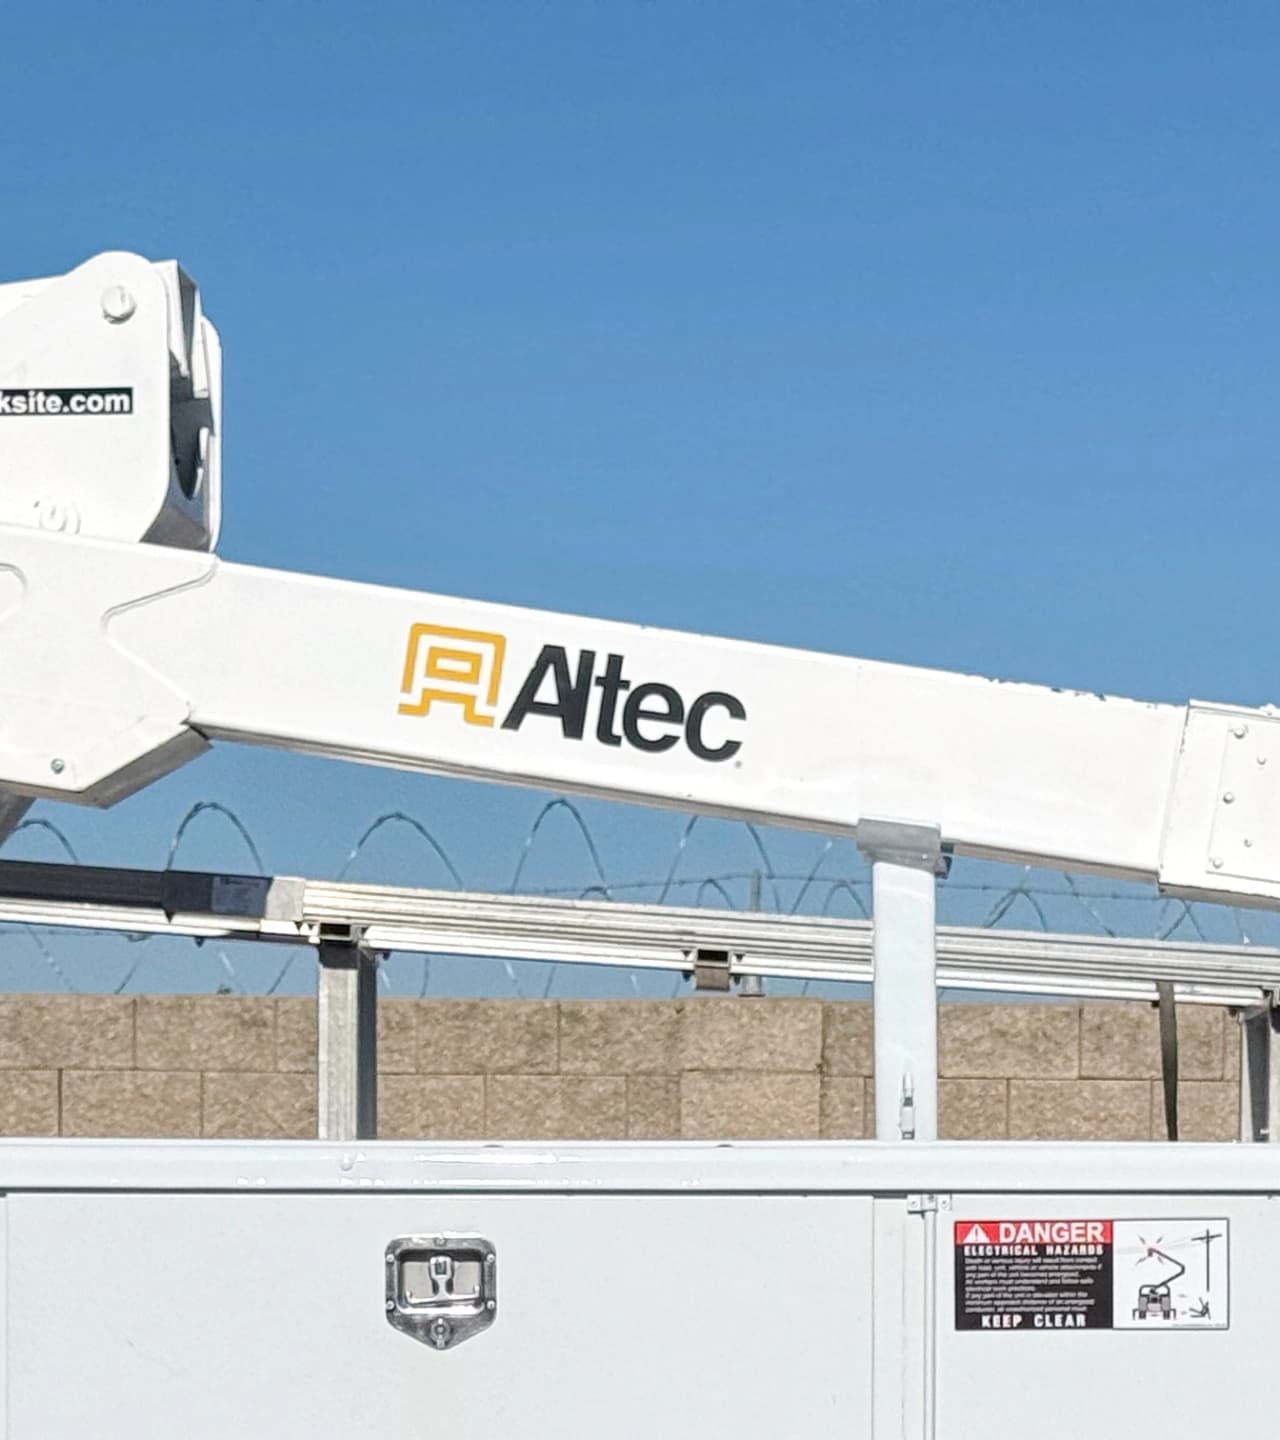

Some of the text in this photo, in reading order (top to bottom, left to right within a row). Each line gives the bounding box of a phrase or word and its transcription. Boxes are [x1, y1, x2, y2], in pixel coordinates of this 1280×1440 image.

[501, 643, 746, 762] Altec
[999, 1222, 1105, 1244] DANGER
[963, 1244, 1104, 1256] ELECTRICAL HAZARDS
[981, 1313, 1087, 1328] KEEP CLEAR
